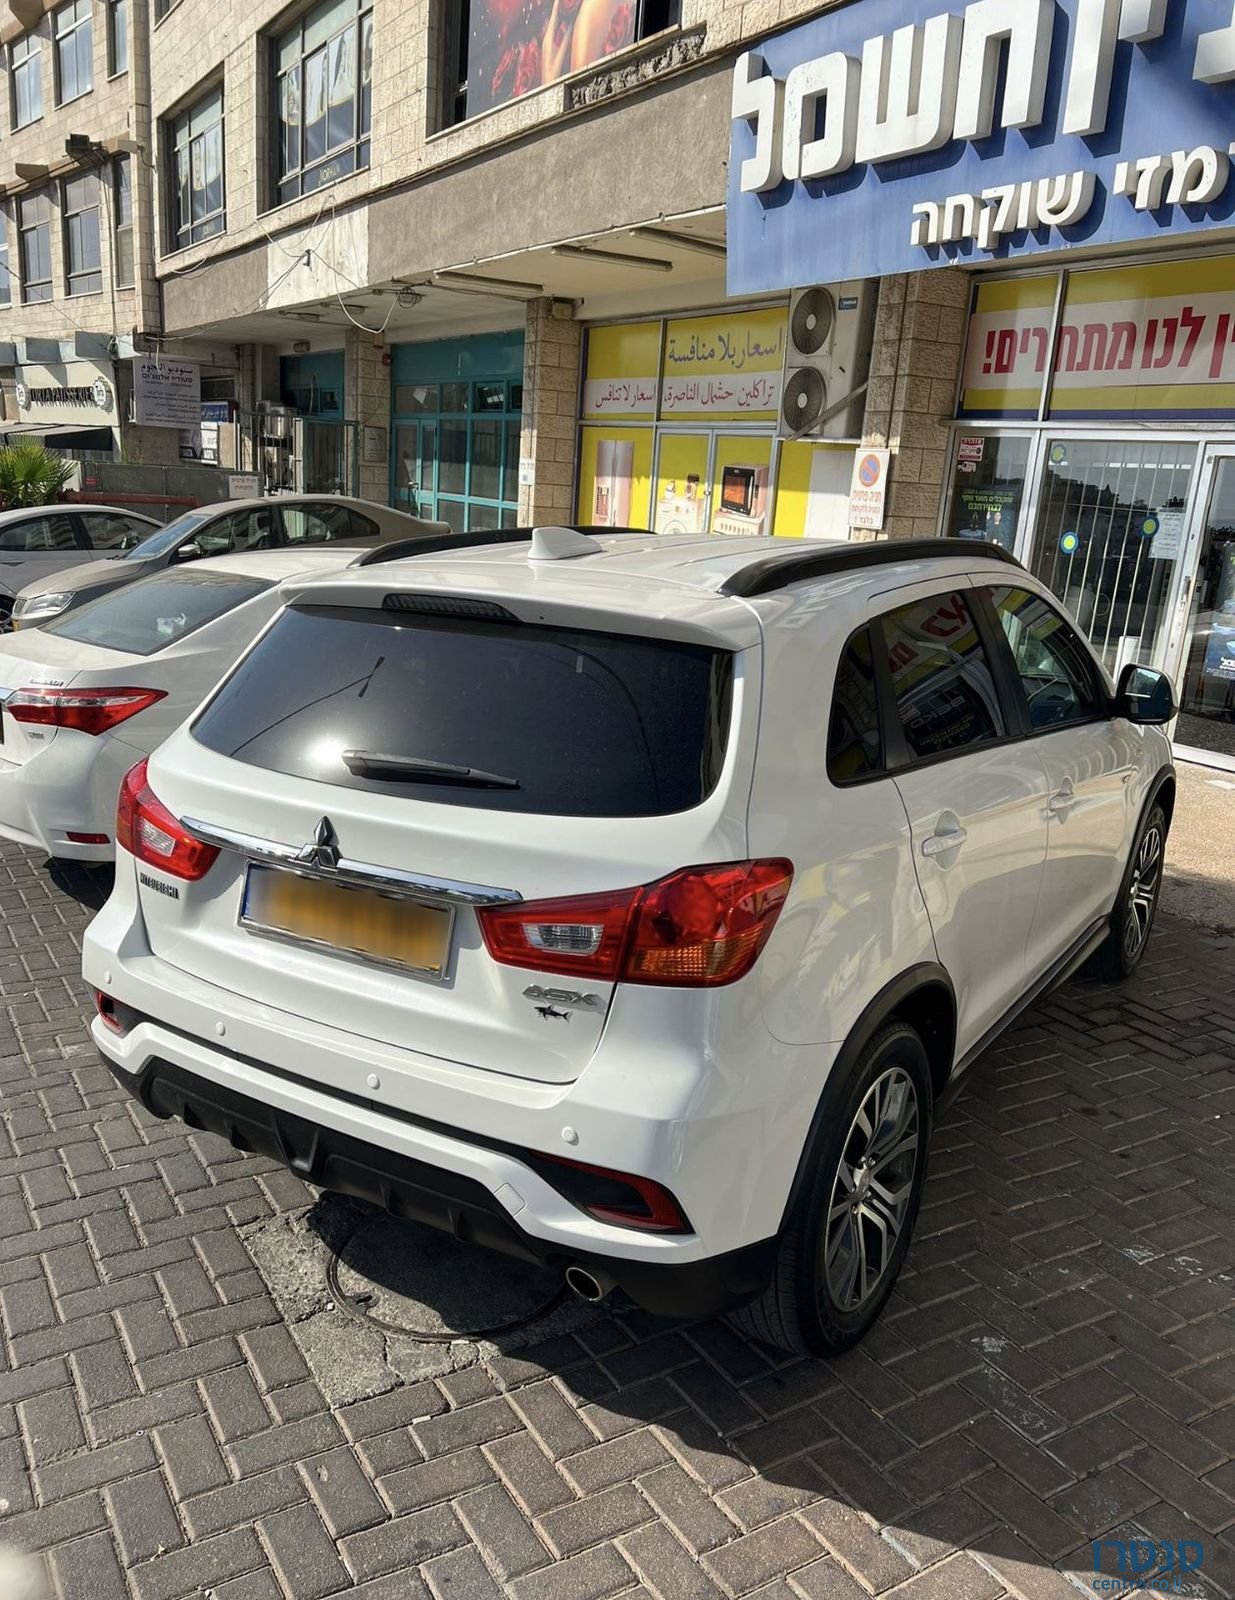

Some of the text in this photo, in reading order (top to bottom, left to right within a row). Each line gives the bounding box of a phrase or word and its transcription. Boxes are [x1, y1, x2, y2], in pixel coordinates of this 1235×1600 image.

[732, 0, 1055, 193] חשמל
[910, 142, 1235, 249] מזי שוקחה
[668, 327, 782, 368] اسعار بلا منافسة
[982, 320, 1137, 374] מתחרים!
[1141, 306, 1206, 369] לנו
